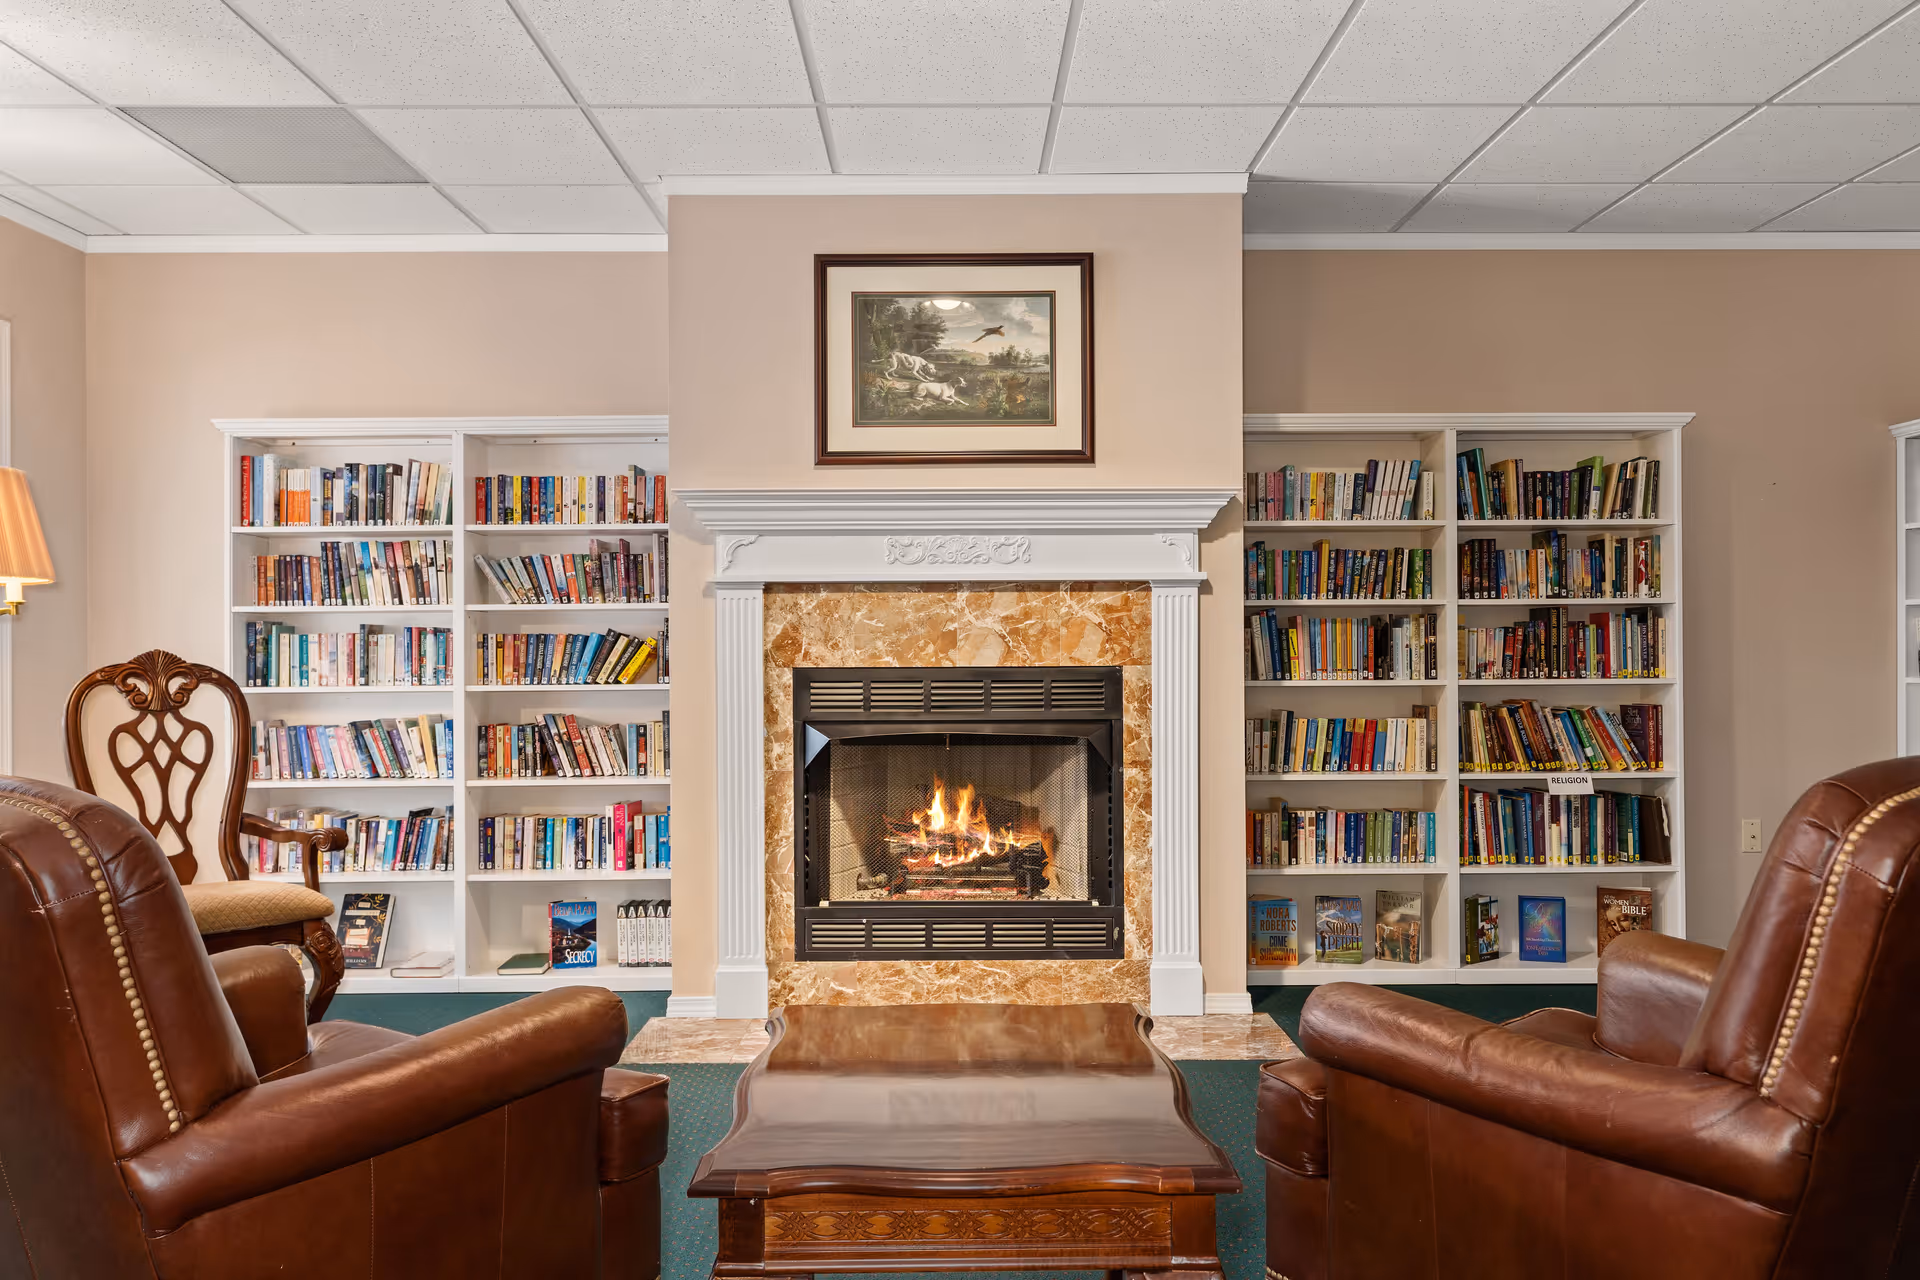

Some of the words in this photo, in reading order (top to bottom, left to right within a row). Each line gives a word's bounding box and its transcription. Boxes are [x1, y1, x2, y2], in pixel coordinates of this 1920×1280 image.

[575, 904, 595, 916] PLAIN
[1266, 907, 1290, 919] NORA
[1622, 906, 1647, 915] BIBLE
[1260, 920, 1296, 931] ROBERTS
[1326, 921, 1359, 936] STORMY
[1269, 936, 1288, 947] COME
[1328, 936, 1361, 951] PETREL
[565, 949, 595, 964] SECRECY
[1260, 948, 1296, 961] SUNDOWN
